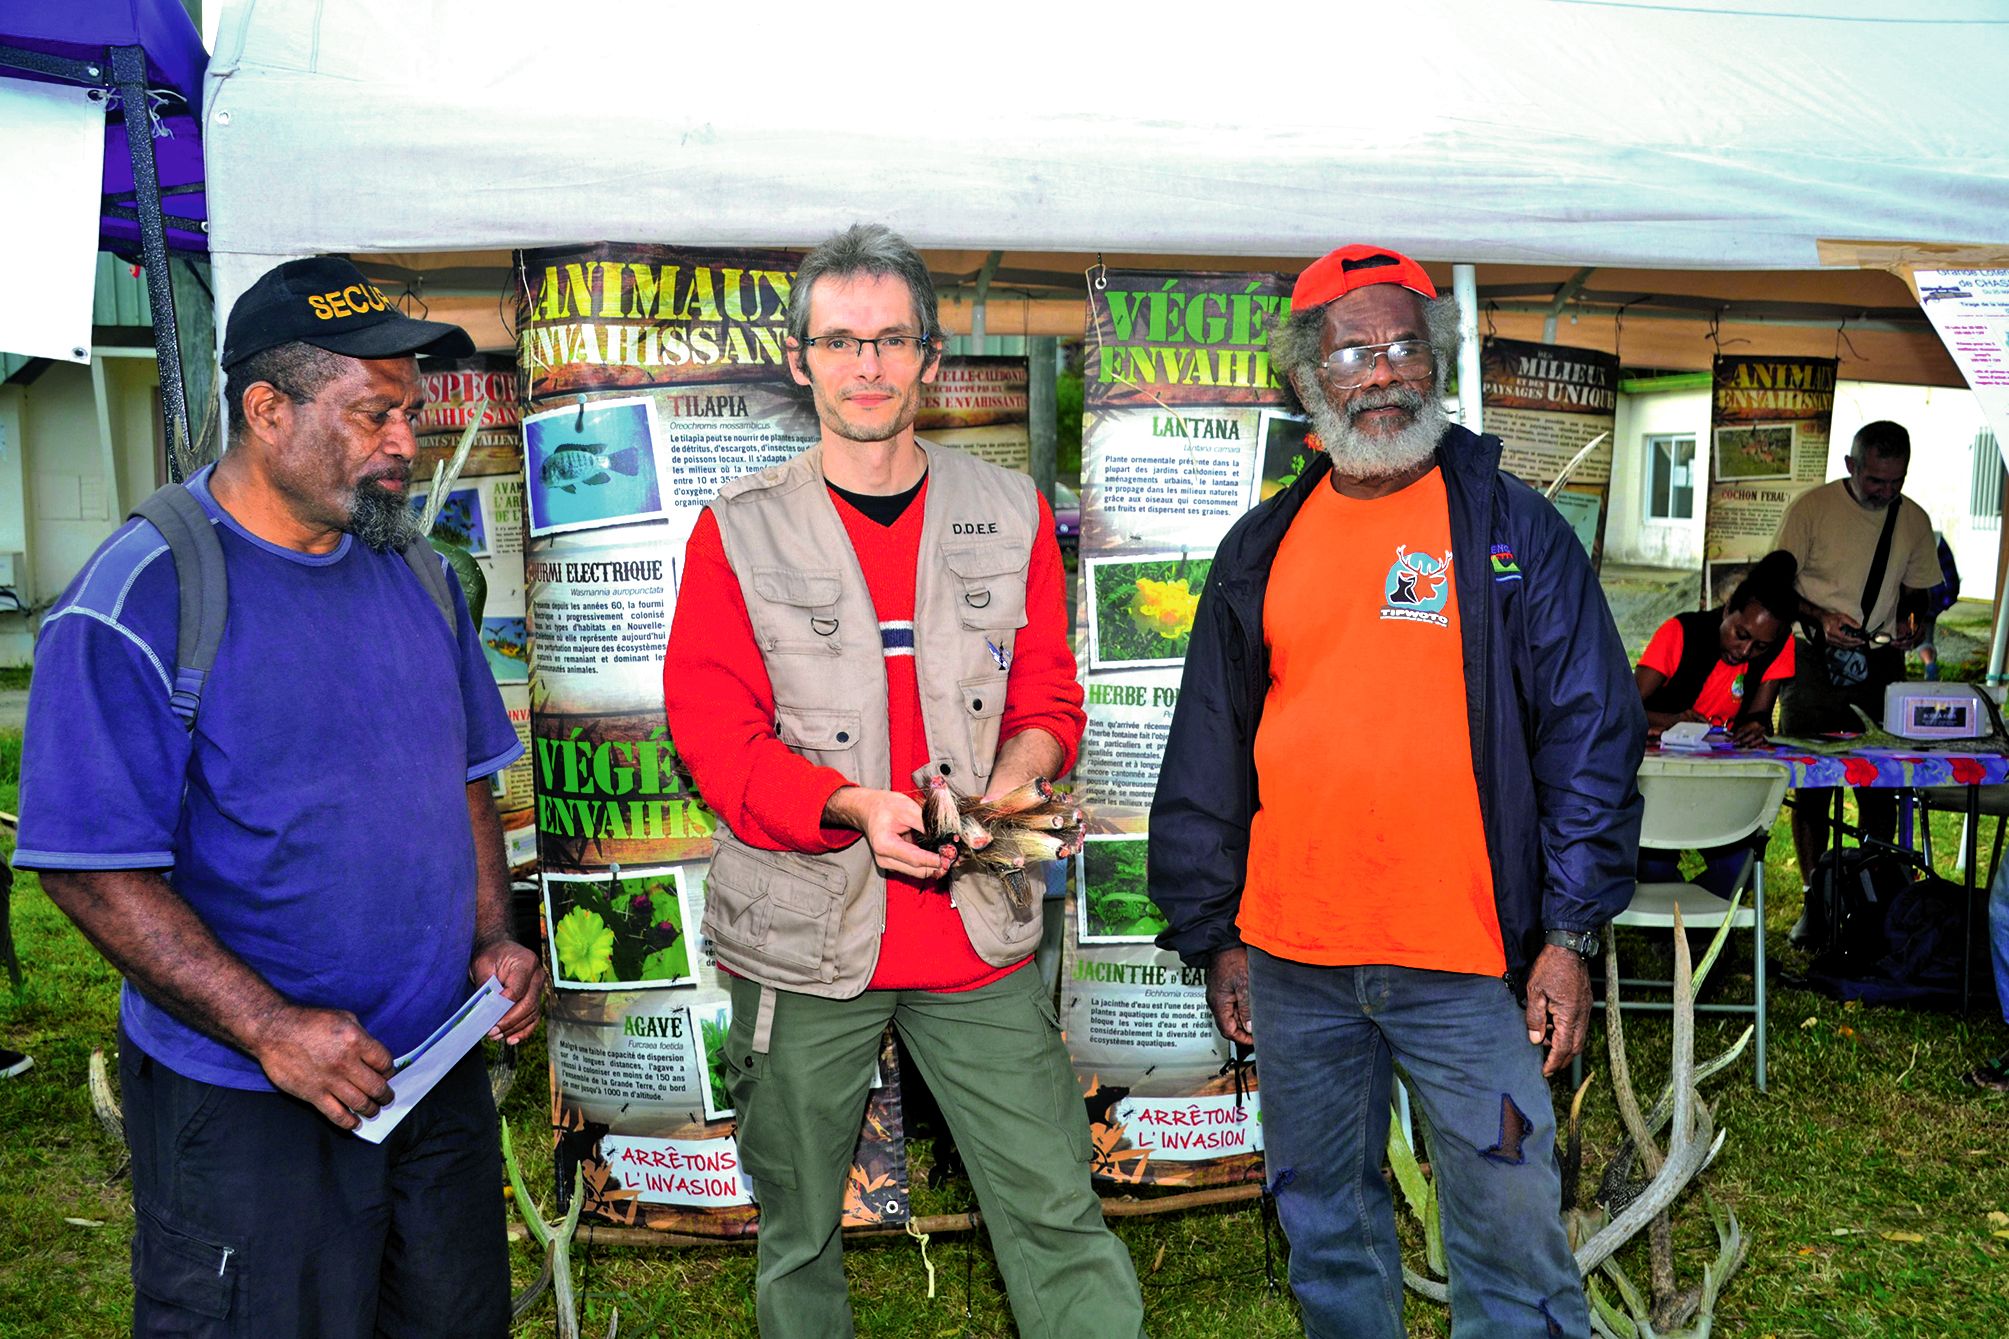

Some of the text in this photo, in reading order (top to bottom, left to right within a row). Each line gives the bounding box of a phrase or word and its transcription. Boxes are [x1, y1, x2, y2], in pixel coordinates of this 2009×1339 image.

[523, 324, 790, 368] ENVAHISSAN
[667, 395, 749, 417] TILAPIA
[1153, 416, 1240, 440] LANTANA
[681, 434, 704, 443] tilapia
[706, 435, 722, 443] peut
[771, 434, 794, 442] plantes
[682, 444, 712, 453] détritus,
[714, 444, 759, 453] d'escargots,
[761, 444, 795, 452] d'insectes
[684, 455, 716, 464] poissons
[719, 455, 746, 463] locaux.
[757, 455, 786, 463] s'adapte
[1131, 456, 1175, 464] ornementale
[673, 466, 684, 474] les
[1105, 466, 1130, 474] plupart
[1153, 467, 1178, 475] jardins
[674, 477, 693, 485] entre
[1105, 475, 1158, 484] aménagements
[1164, 477, 1193, 485] urbains,
[674, 488, 715, 497] d'oxygène,
[1116, 486, 1144, 495] propage
[1180, 487, 1206, 495] milieux
[1210, 488, 1238, 496] naturels
[1104, 496, 1124, 504] grâce
[1178, 497, 1188, 505] qui
[1148, 506, 1185, 515] dispersent
[1202, 508, 1231, 516] graines.
[566, 560, 663, 583] ELECTRIQUE
[571, 587, 664, 597] Wasmannia auropunctata
[571, 600, 664, 611] les années 60, fourmi
[567, 611, 664, 622] progressivement colonisé
[627, 621, 665, 630] Nouvelle-
[580, 632, 666, 643] représente aujourd'hui
[573, 643, 666, 654] majeure des écosystèmes
[564, 654, 649, 663] remaniant dominant
[567, 666, 599, 674] animales.
[1089, 684, 1147, 706] HERBE
[1089, 719, 1139, 730] Bien qu'arrivée
[1104, 741, 1141, 749] particuliers
[1088, 749, 1161, 759] qualités ornementales.
[537, 726, 701, 795] VÉGÉ
[1088, 759, 1123, 768] rapidement
[1111, 770, 1145, 778] cantonnée
[1072, 960, 1167, 985] JACINTHE
[1145, 989, 1181, 997] Eichhornia
[1091, 998, 1099, 1006] La
[1101, 999, 1129, 1008] jacinthe
[1131, 1000, 1150, 1008] d'eau
[1091, 1008, 1116, 1017] plantes
[1119, 1010, 1157, 1020] aquatiques
[1172, 1011, 1197, 1019] monde.
[624, 1015, 683, 1037] AGAVE
[1091, 1017, 1114, 1027] bloque
[1134, 1020, 1153, 1028] voies
[1090, 1027, 1152, 1037] considérablement
[1166, 1030, 1197, 1038] diversité
[1200, 1030, 1212, 1038] des
[659, 1042, 684, 1050] foetida
[1090, 1036, 1177, 1048] écosystèmes aquatiques.
[560, 1041, 684, 1062] Malgré capacité de dispersion
[583, 1055, 674, 1073] longues distances, l'agave
[584, 1066, 610, 1076] coloniser
[623, 1070, 642, 1079] moins
[645, 1072, 653, 1080] de
[656, 1073, 670, 1081] 150
[562, 1070, 686, 1092] l'ensemble Grande Terre, bord
[581, 1083, 663, 1101] jusqu'à 1000 d'altitude.
[1138, 1104, 1248, 1126] ARRÊTONS
[622, 1146, 736, 1171] ARRÊTONS
